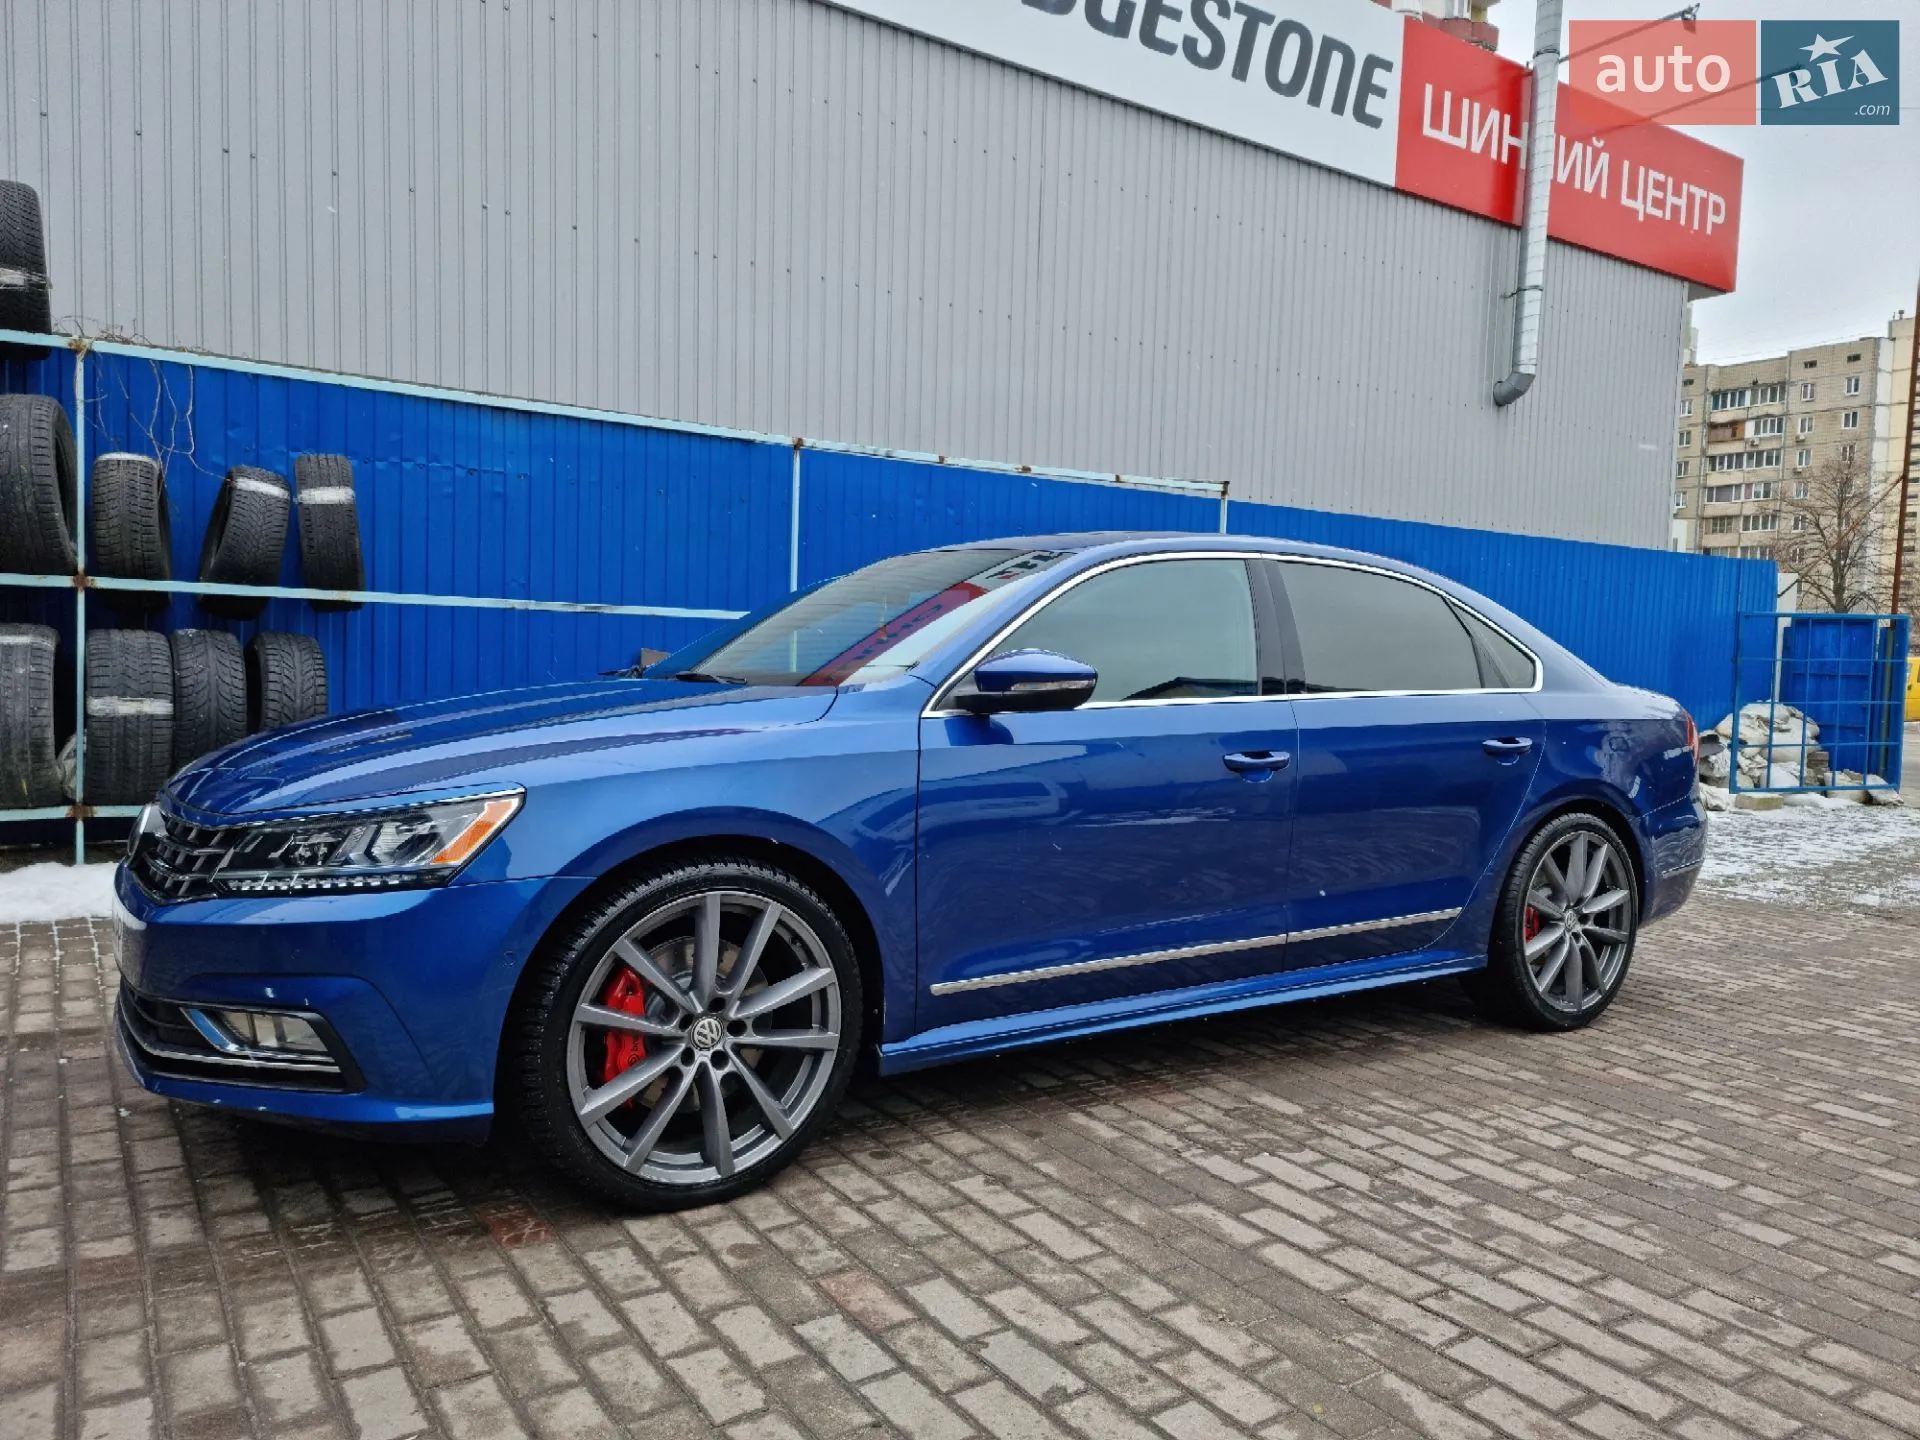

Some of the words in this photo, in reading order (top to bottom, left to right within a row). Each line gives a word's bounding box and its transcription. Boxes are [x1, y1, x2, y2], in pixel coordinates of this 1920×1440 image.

[1020, 0, 1394, 130] ESTONE
[1422, 83, 1610, 200] ШИНИЙ
[1620, 160, 1727, 236] ЦЕНТР
